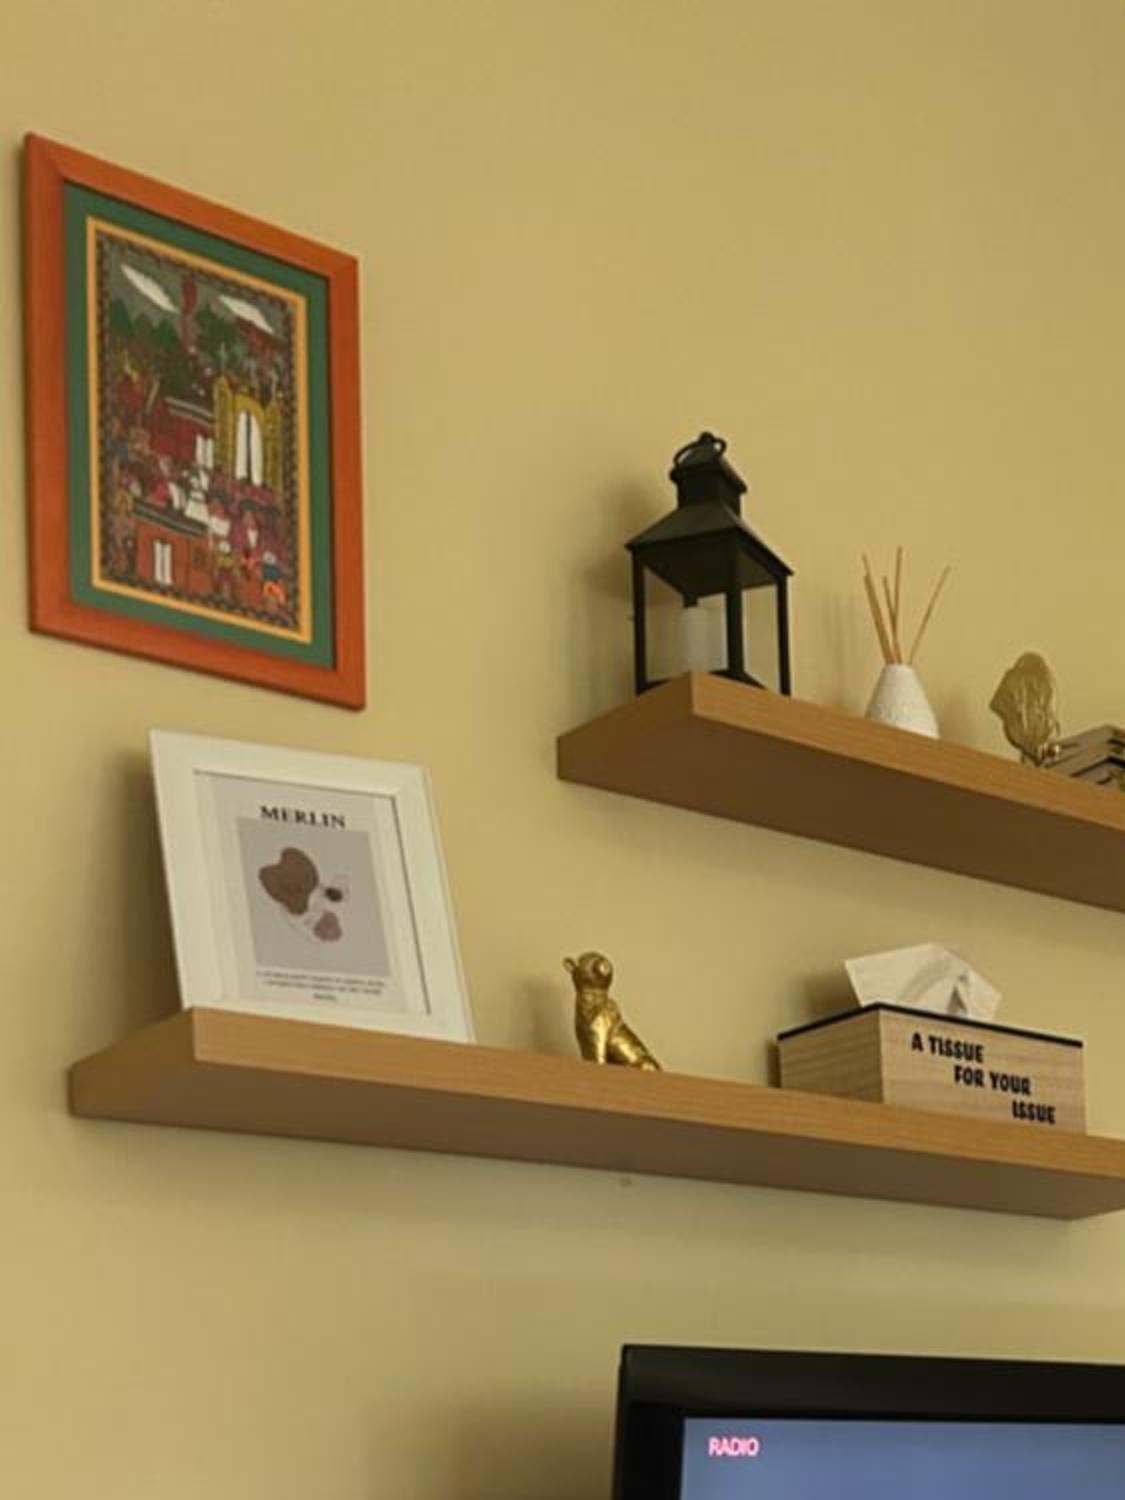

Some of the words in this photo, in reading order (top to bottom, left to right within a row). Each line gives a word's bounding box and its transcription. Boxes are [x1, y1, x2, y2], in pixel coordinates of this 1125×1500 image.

[260, 804, 346, 829] MERLIN
[911, 1031, 924, 1052] A
[928, 1034, 984, 1063] TISSUE
[954, 1065, 985, 1088] FOR
[989, 1071, 1031, 1096] YOUR
[1012, 1100, 1056, 1124] ISSUE
[708, 1436, 759, 1457] RADIO
